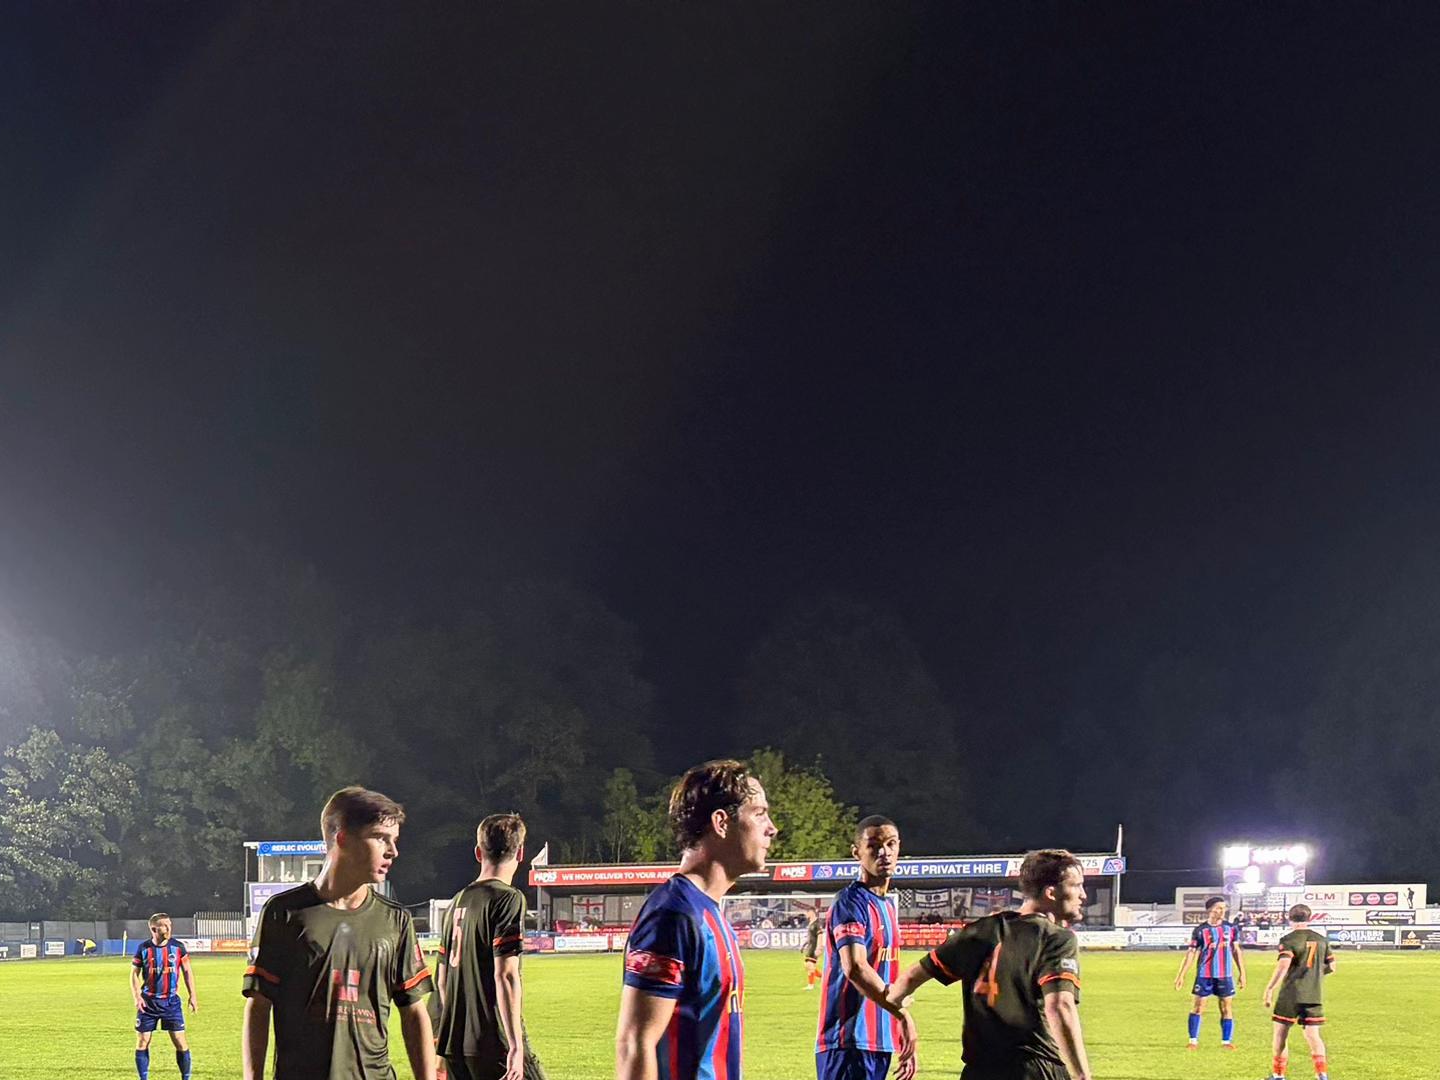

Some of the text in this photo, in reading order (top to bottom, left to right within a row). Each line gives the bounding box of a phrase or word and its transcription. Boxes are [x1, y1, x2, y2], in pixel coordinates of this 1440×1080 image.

[271, 844, 296, 852] REFLEC
[562, 873, 573, 881] WE
[594, 872, 623, 880] DELIVER
[624, 871, 634, 879] TO
[635, 871, 656, 879] YOUR
[921, 863, 974, 875] PRIVATE
[977, 863, 1002, 873] HIRE
[449, 907, 467, 968] 5
[1305, 941, 1319, 968] 7
[973, 942, 1002, 1007] 4
